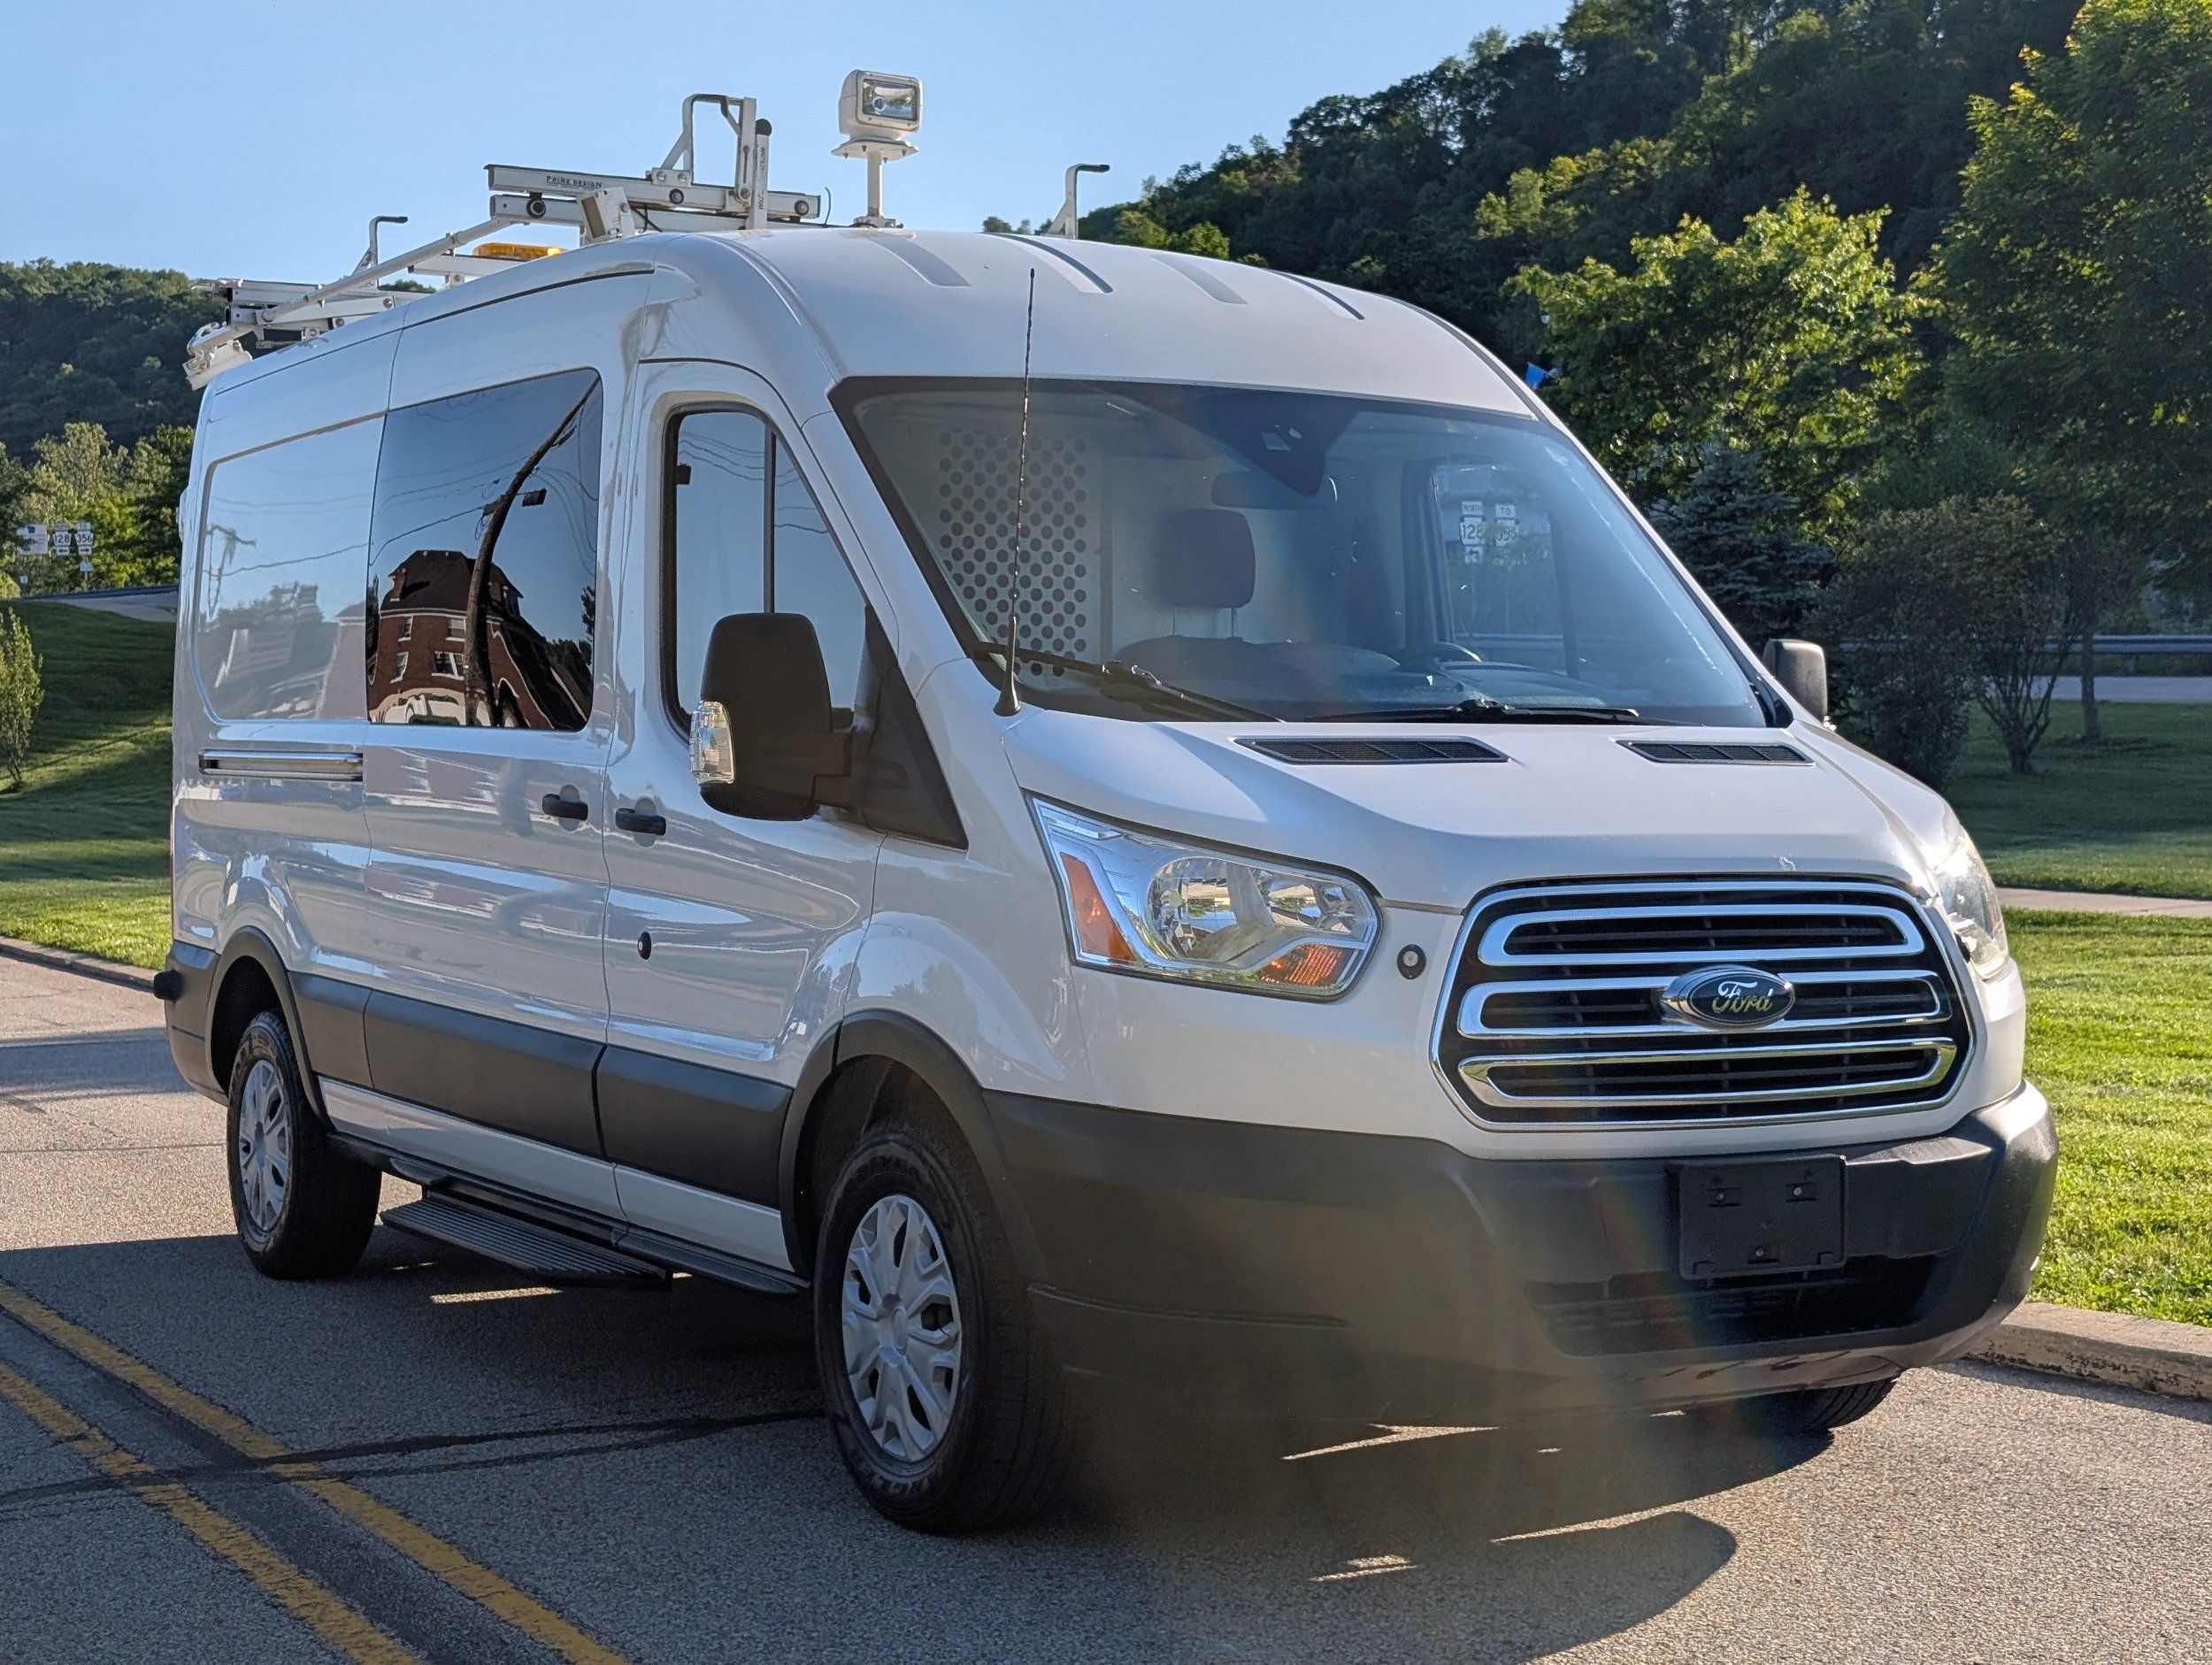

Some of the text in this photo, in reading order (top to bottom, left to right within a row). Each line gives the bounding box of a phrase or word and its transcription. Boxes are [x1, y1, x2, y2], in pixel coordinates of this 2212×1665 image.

[55, 533, 70, 543] 128
[1462, 524, 1486, 541] 128
[1711, 980, 1774, 1014] Ford
